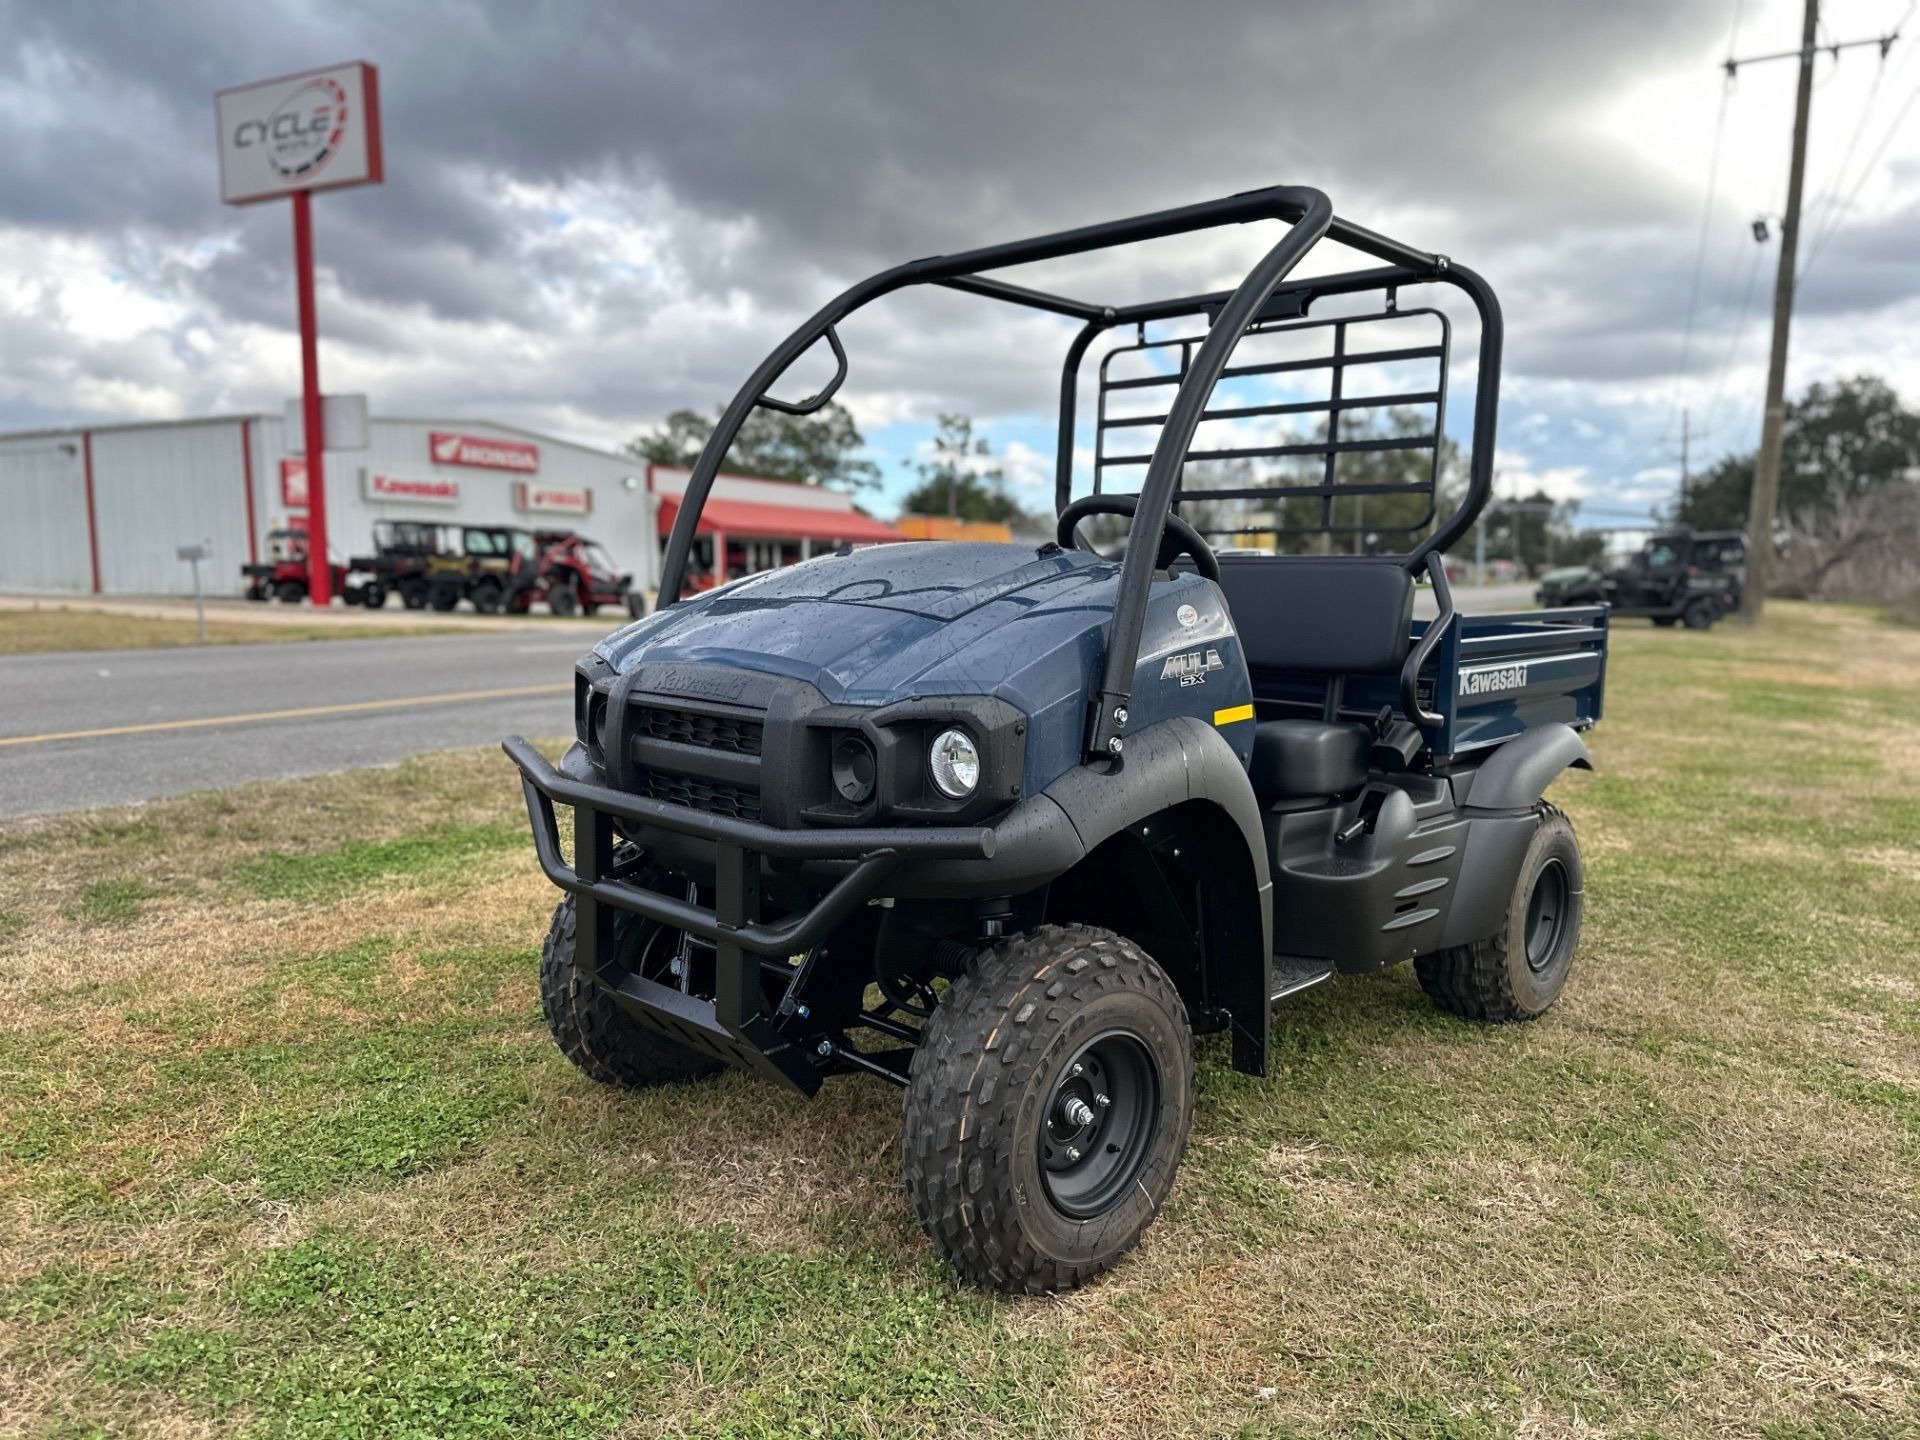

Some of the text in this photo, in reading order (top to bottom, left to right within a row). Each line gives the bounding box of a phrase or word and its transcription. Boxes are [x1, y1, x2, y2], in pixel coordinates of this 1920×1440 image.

[234, 107, 331, 148] CYCLE
[461, 445, 536, 469] HONDA
[1160, 649, 1224, 680] MULE
[1458, 664, 1528, 696] Kawasaki
[1180, 673, 1206, 688] SX
